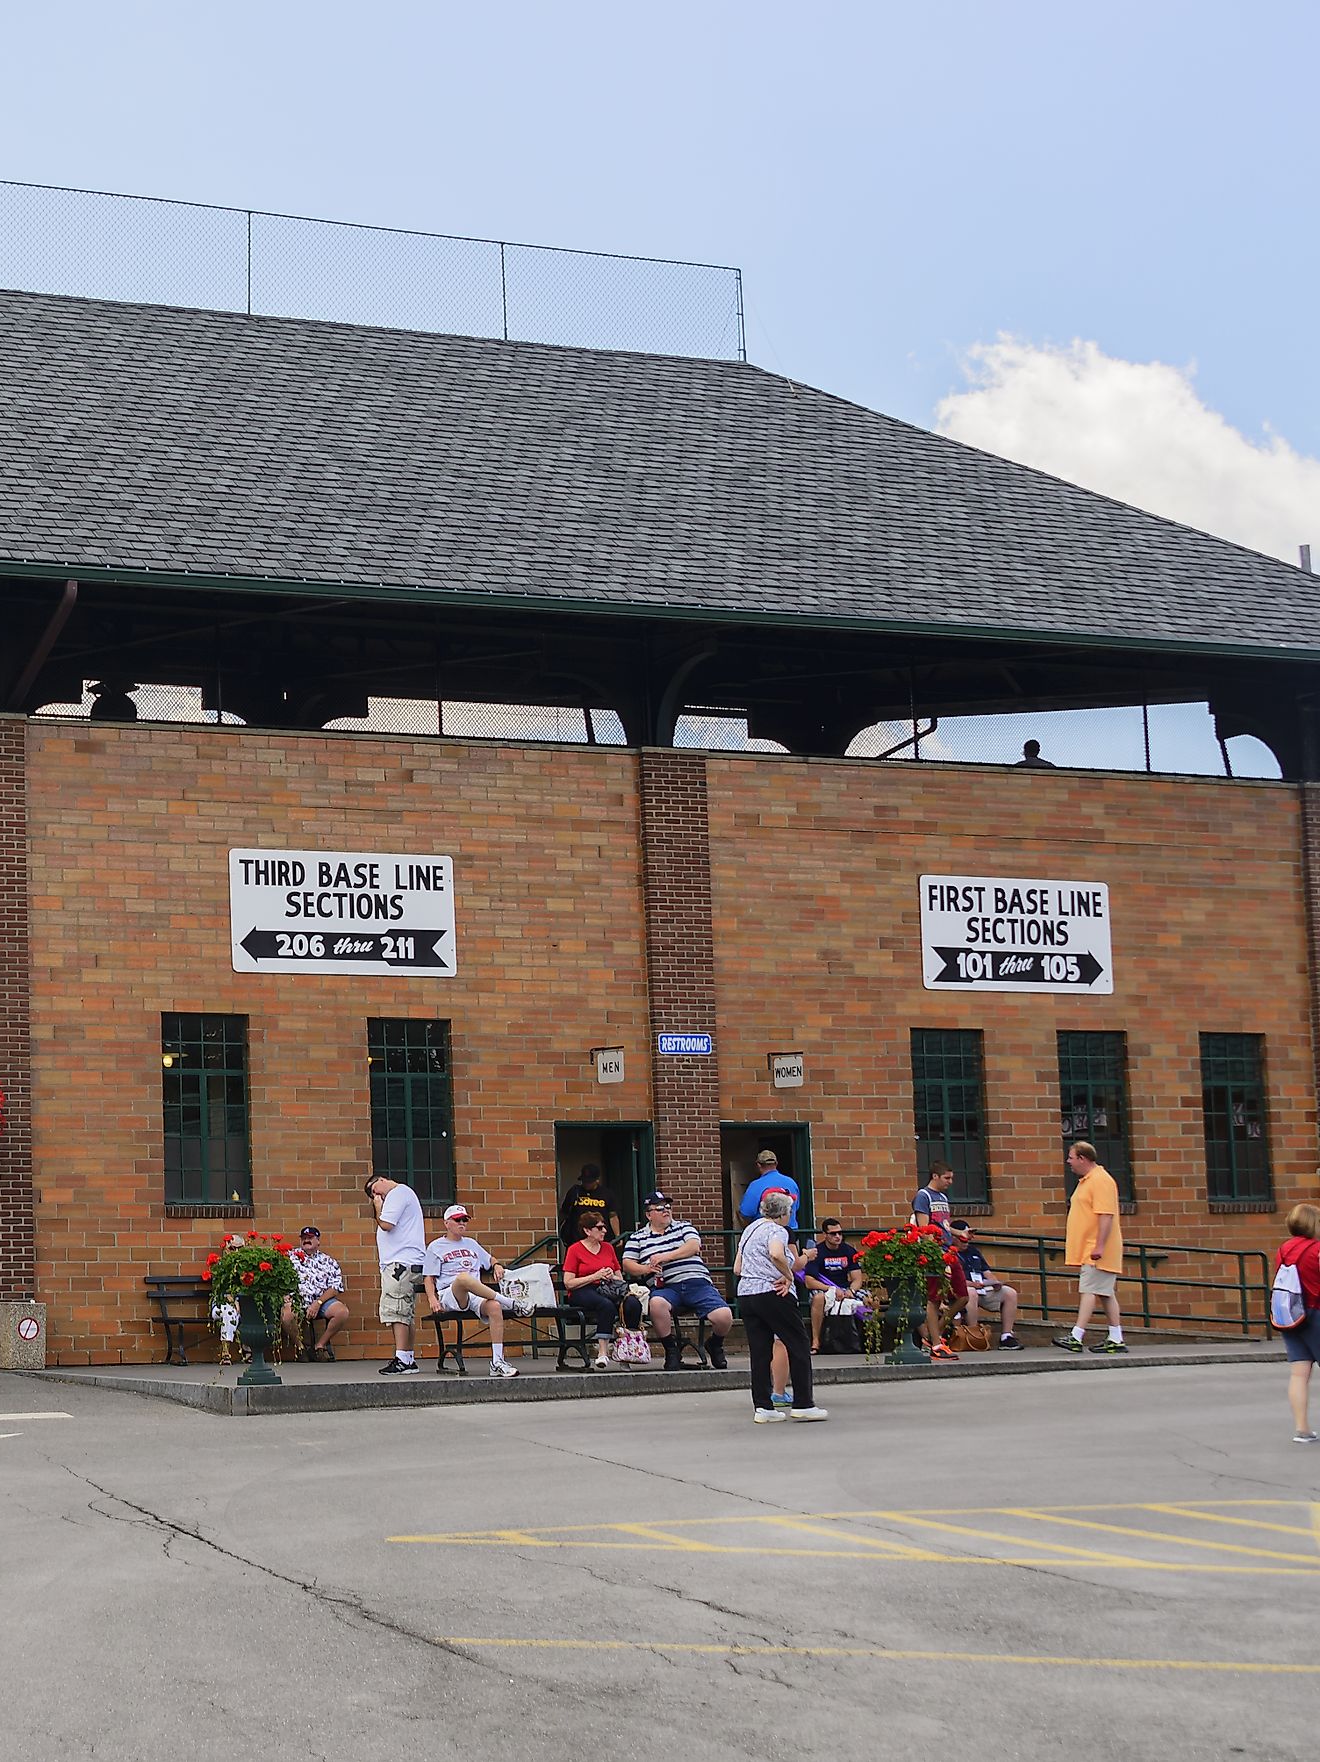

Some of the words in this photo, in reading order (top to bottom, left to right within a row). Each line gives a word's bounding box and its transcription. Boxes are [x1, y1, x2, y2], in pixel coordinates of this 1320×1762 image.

[239, 858, 306, 887] THIRD
[318, 862, 380, 889] BASE
[394, 864, 444, 891] LINE
[285, 892, 404, 920] SECTIONS
[928, 884, 986, 914] FIRST
[994, 887, 1049, 915] BASE
[1058, 890, 1103, 918] LINE
[966, 917, 1069, 946] SECTIONS
[275, 934, 325, 957] 206
[332, 937, 373, 956] thru
[380, 936, 415, 960] 211
[957, 952, 994, 979] 101
[998, 954, 1034, 976] thru
[1041, 955, 1081, 982] 105
[661, 1036, 709, 1052] RESTROOMS
[602, 1061, 620, 1073] MEN
[774, 1066, 802, 1078] WOMEN
